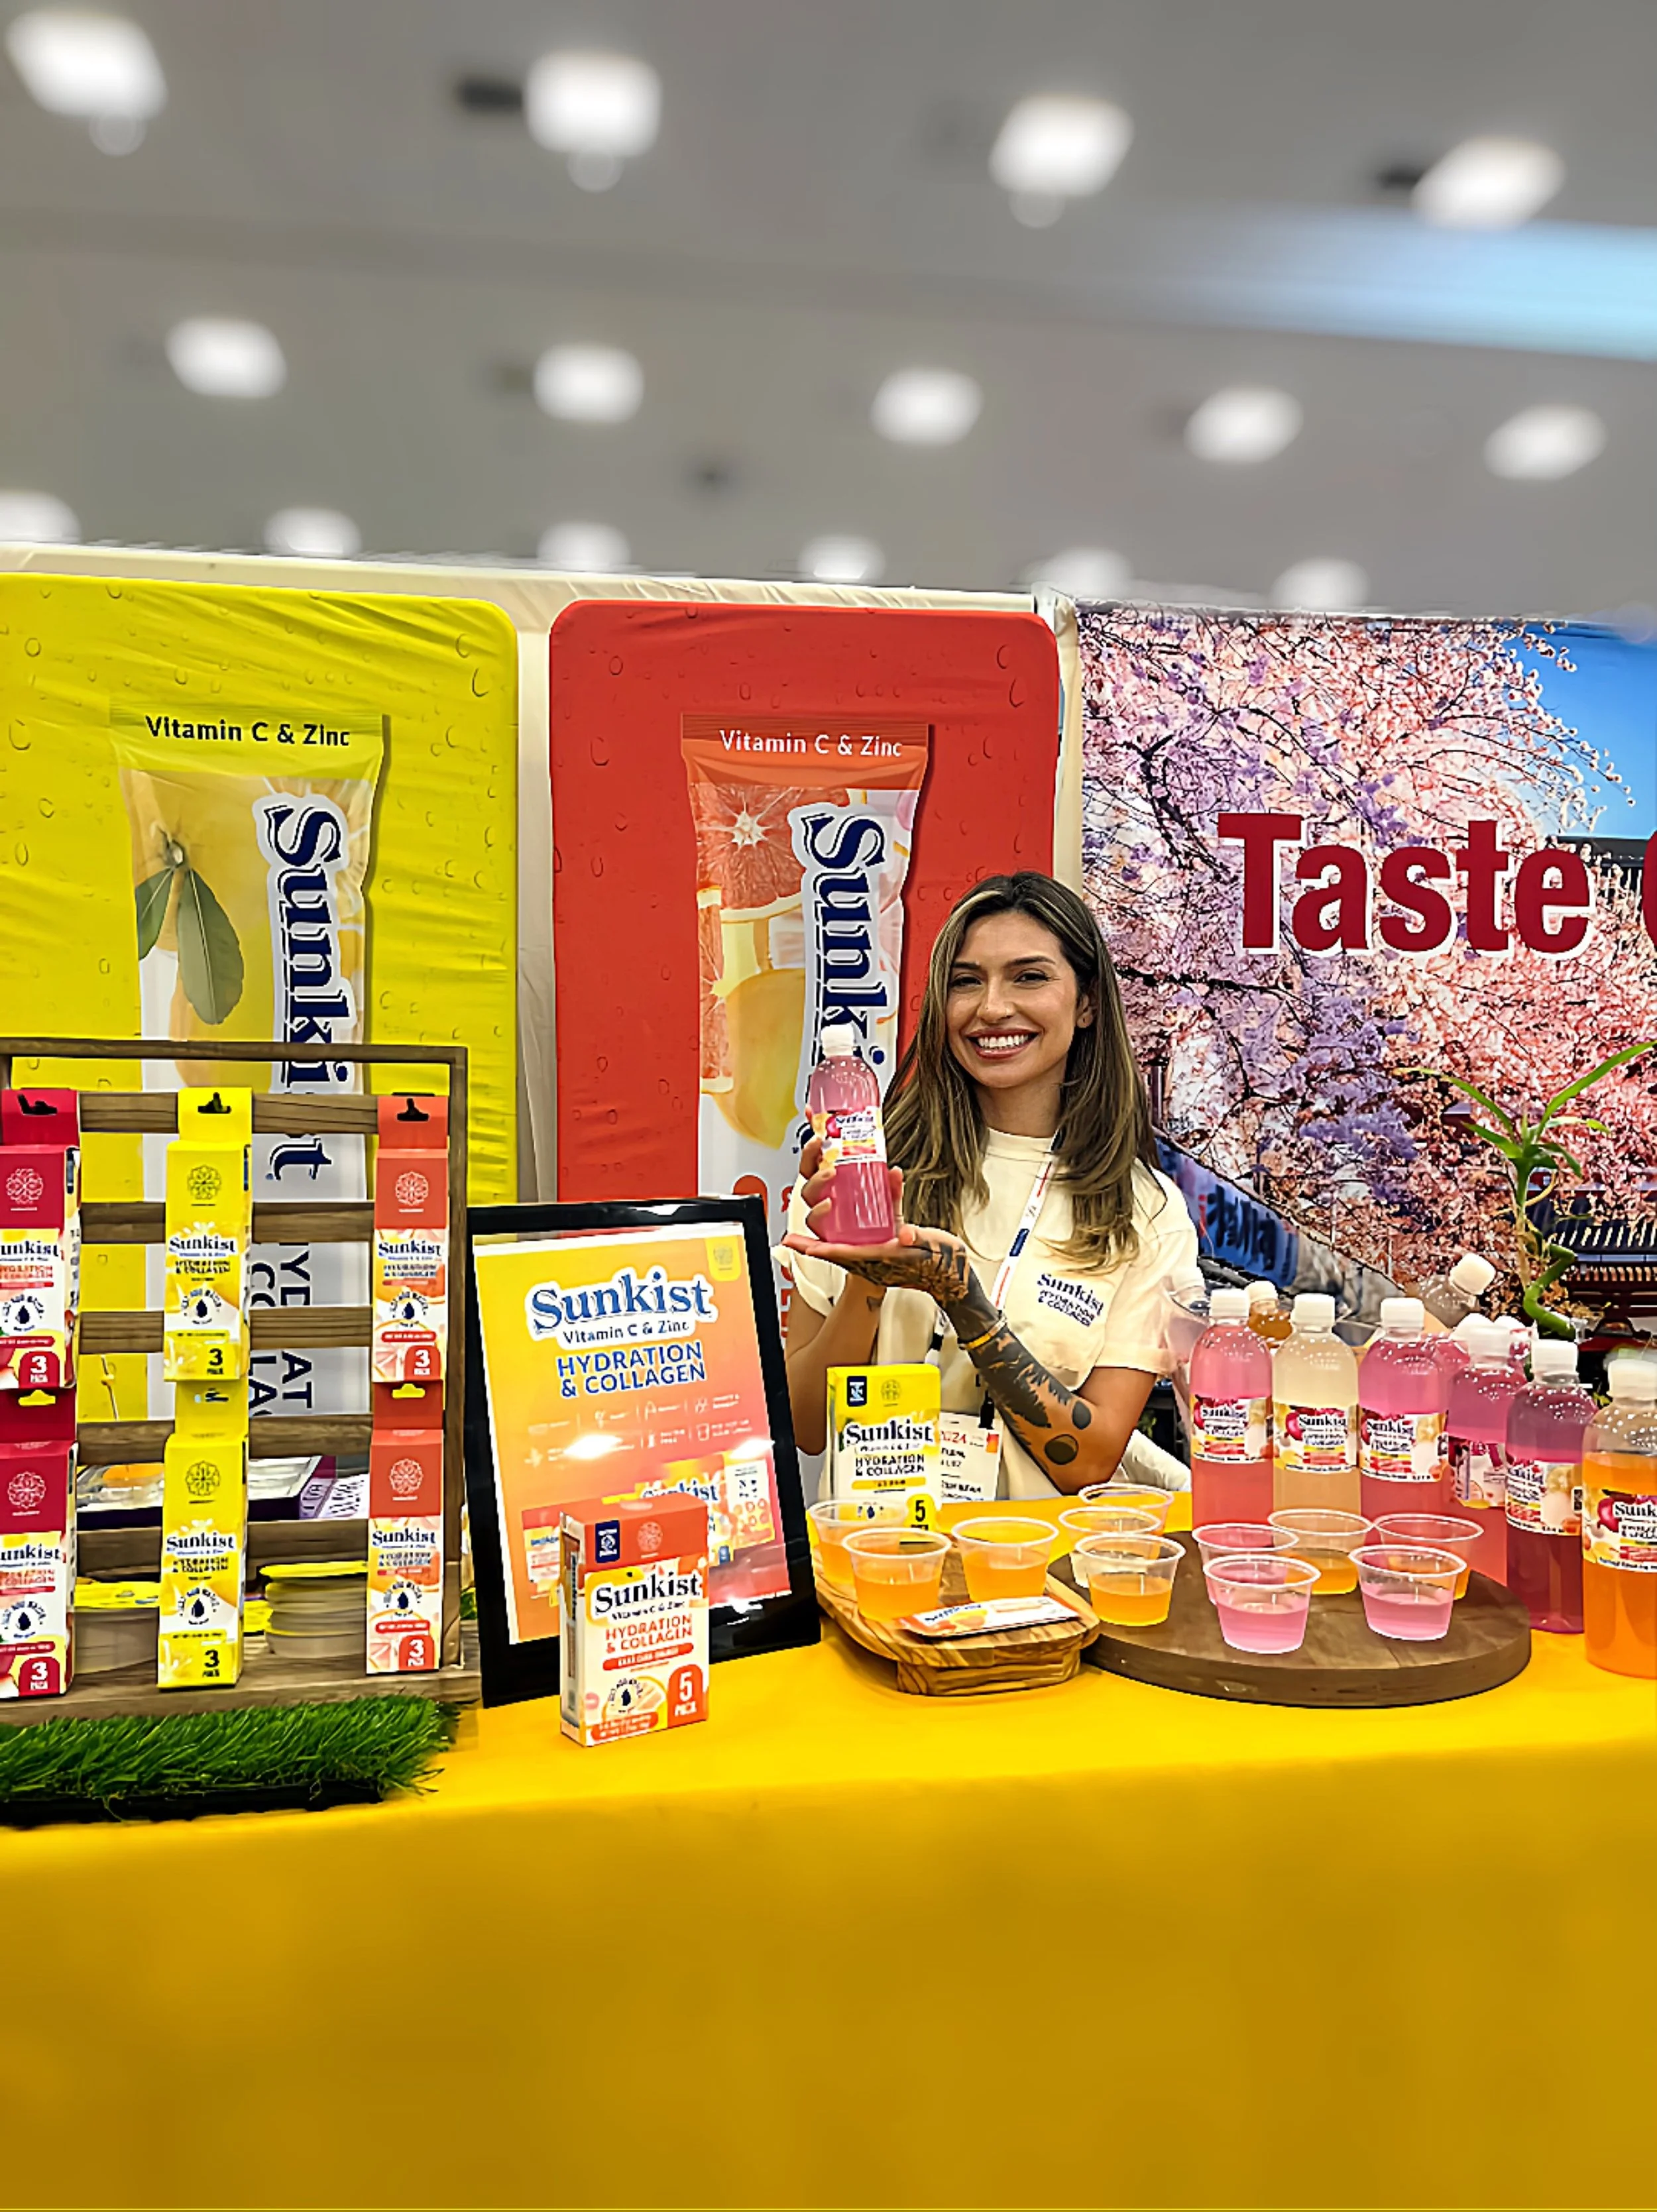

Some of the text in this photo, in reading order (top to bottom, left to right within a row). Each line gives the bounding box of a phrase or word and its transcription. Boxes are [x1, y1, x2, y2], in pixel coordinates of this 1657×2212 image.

[145, 716, 350, 746] Vitamin C & Zinc
[719, 730, 903, 757] Vitamin C & Zinc
[1218, 813, 1590, 953] Taste
[170, 1235, 236, 1252] Sunkist
[531, 1271, 713, 1333] Sunkist
[563, 1320, 689, 1344] Vitamin C & Zinc
[30, 1356, 47, 1374] 3
[208, 1348, 223, 1366] 3
[415, 1349, 430, 1367] 3
[557, 1342, 703, 1377] HYDRATION
[561, 1362, 706, 1398] & COLLAGEN
[846, 1418, 933, 1446] Sunkist
[915, 1500, 926, 1521] 5
[166, 1532, 234, 1551] Sunkist
[372, 1527, 436, 1546] Sunkist
[596, 1571, 701, 1614] Sunkist
[605, 1613, 693, 1641] HYDRATION
[204, 1649, 220, 1668] 3
[408, 1639, 424, 1657] 3
[31, 1662, 48, 1681] 3
[679, 1671, 693, 1702] 5
